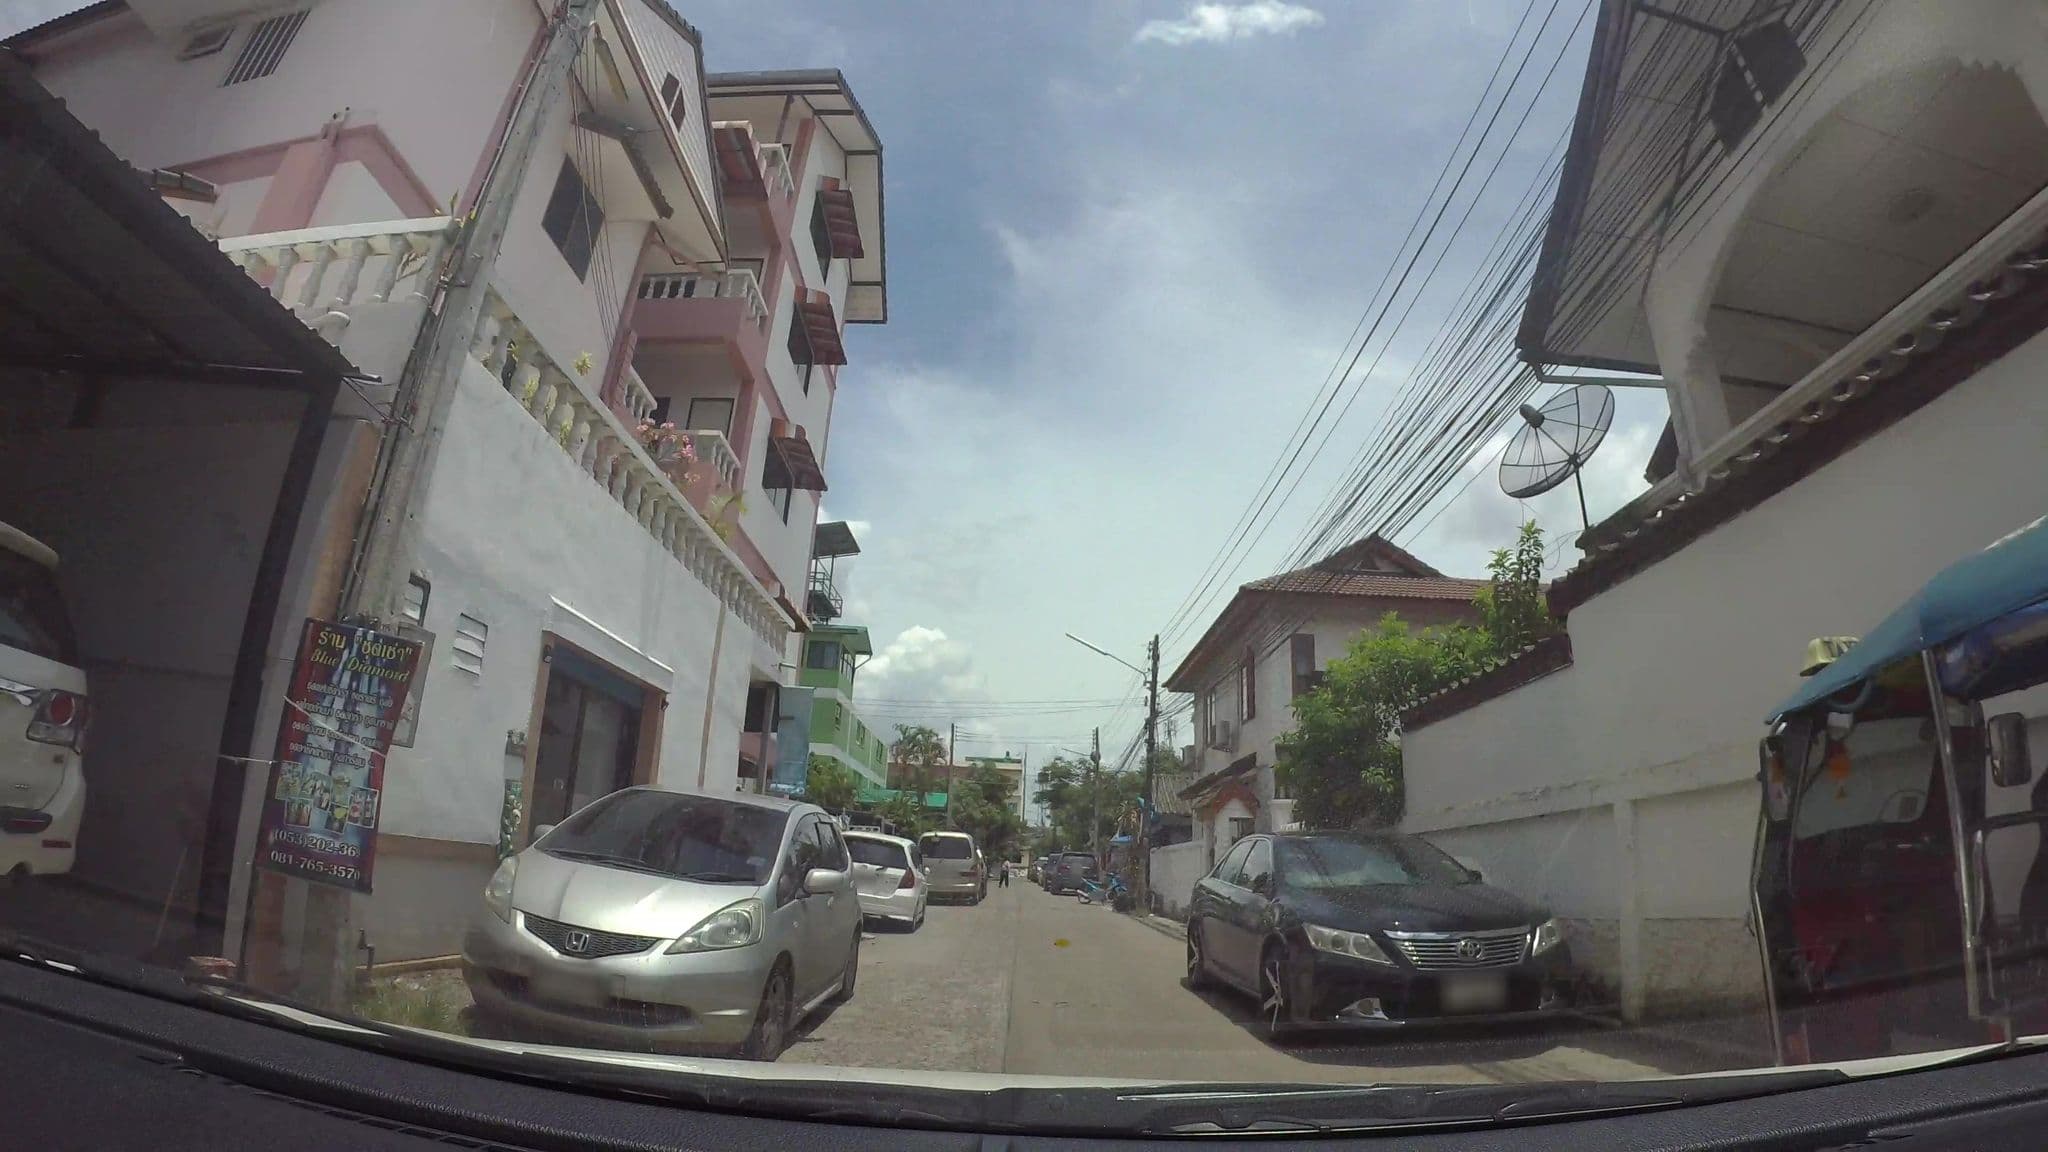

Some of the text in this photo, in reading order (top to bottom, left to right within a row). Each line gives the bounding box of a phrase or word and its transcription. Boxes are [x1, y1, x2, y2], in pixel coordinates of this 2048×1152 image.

[318, 627, 346, 650] ร้าน
[310, 649, 410, 682] Blue Diamond
